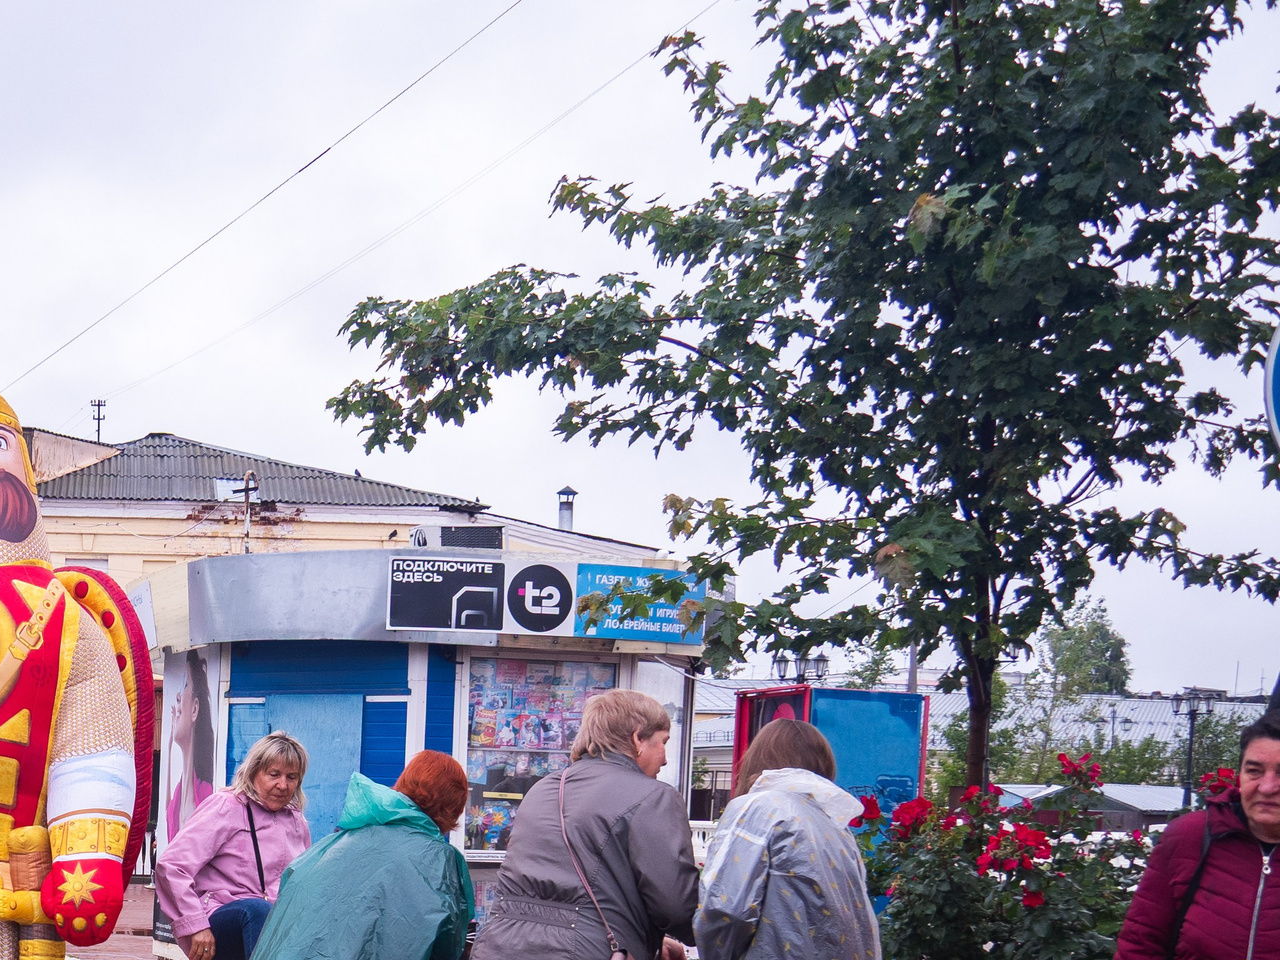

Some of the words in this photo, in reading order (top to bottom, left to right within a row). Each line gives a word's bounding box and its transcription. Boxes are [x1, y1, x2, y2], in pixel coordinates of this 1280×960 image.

[393, 560, 493, 574] ПОДКЛЮЧИТЕ
[392, 571, 443, 583] ЗДЕСЬ
[517, 581, 561, 615] t2
